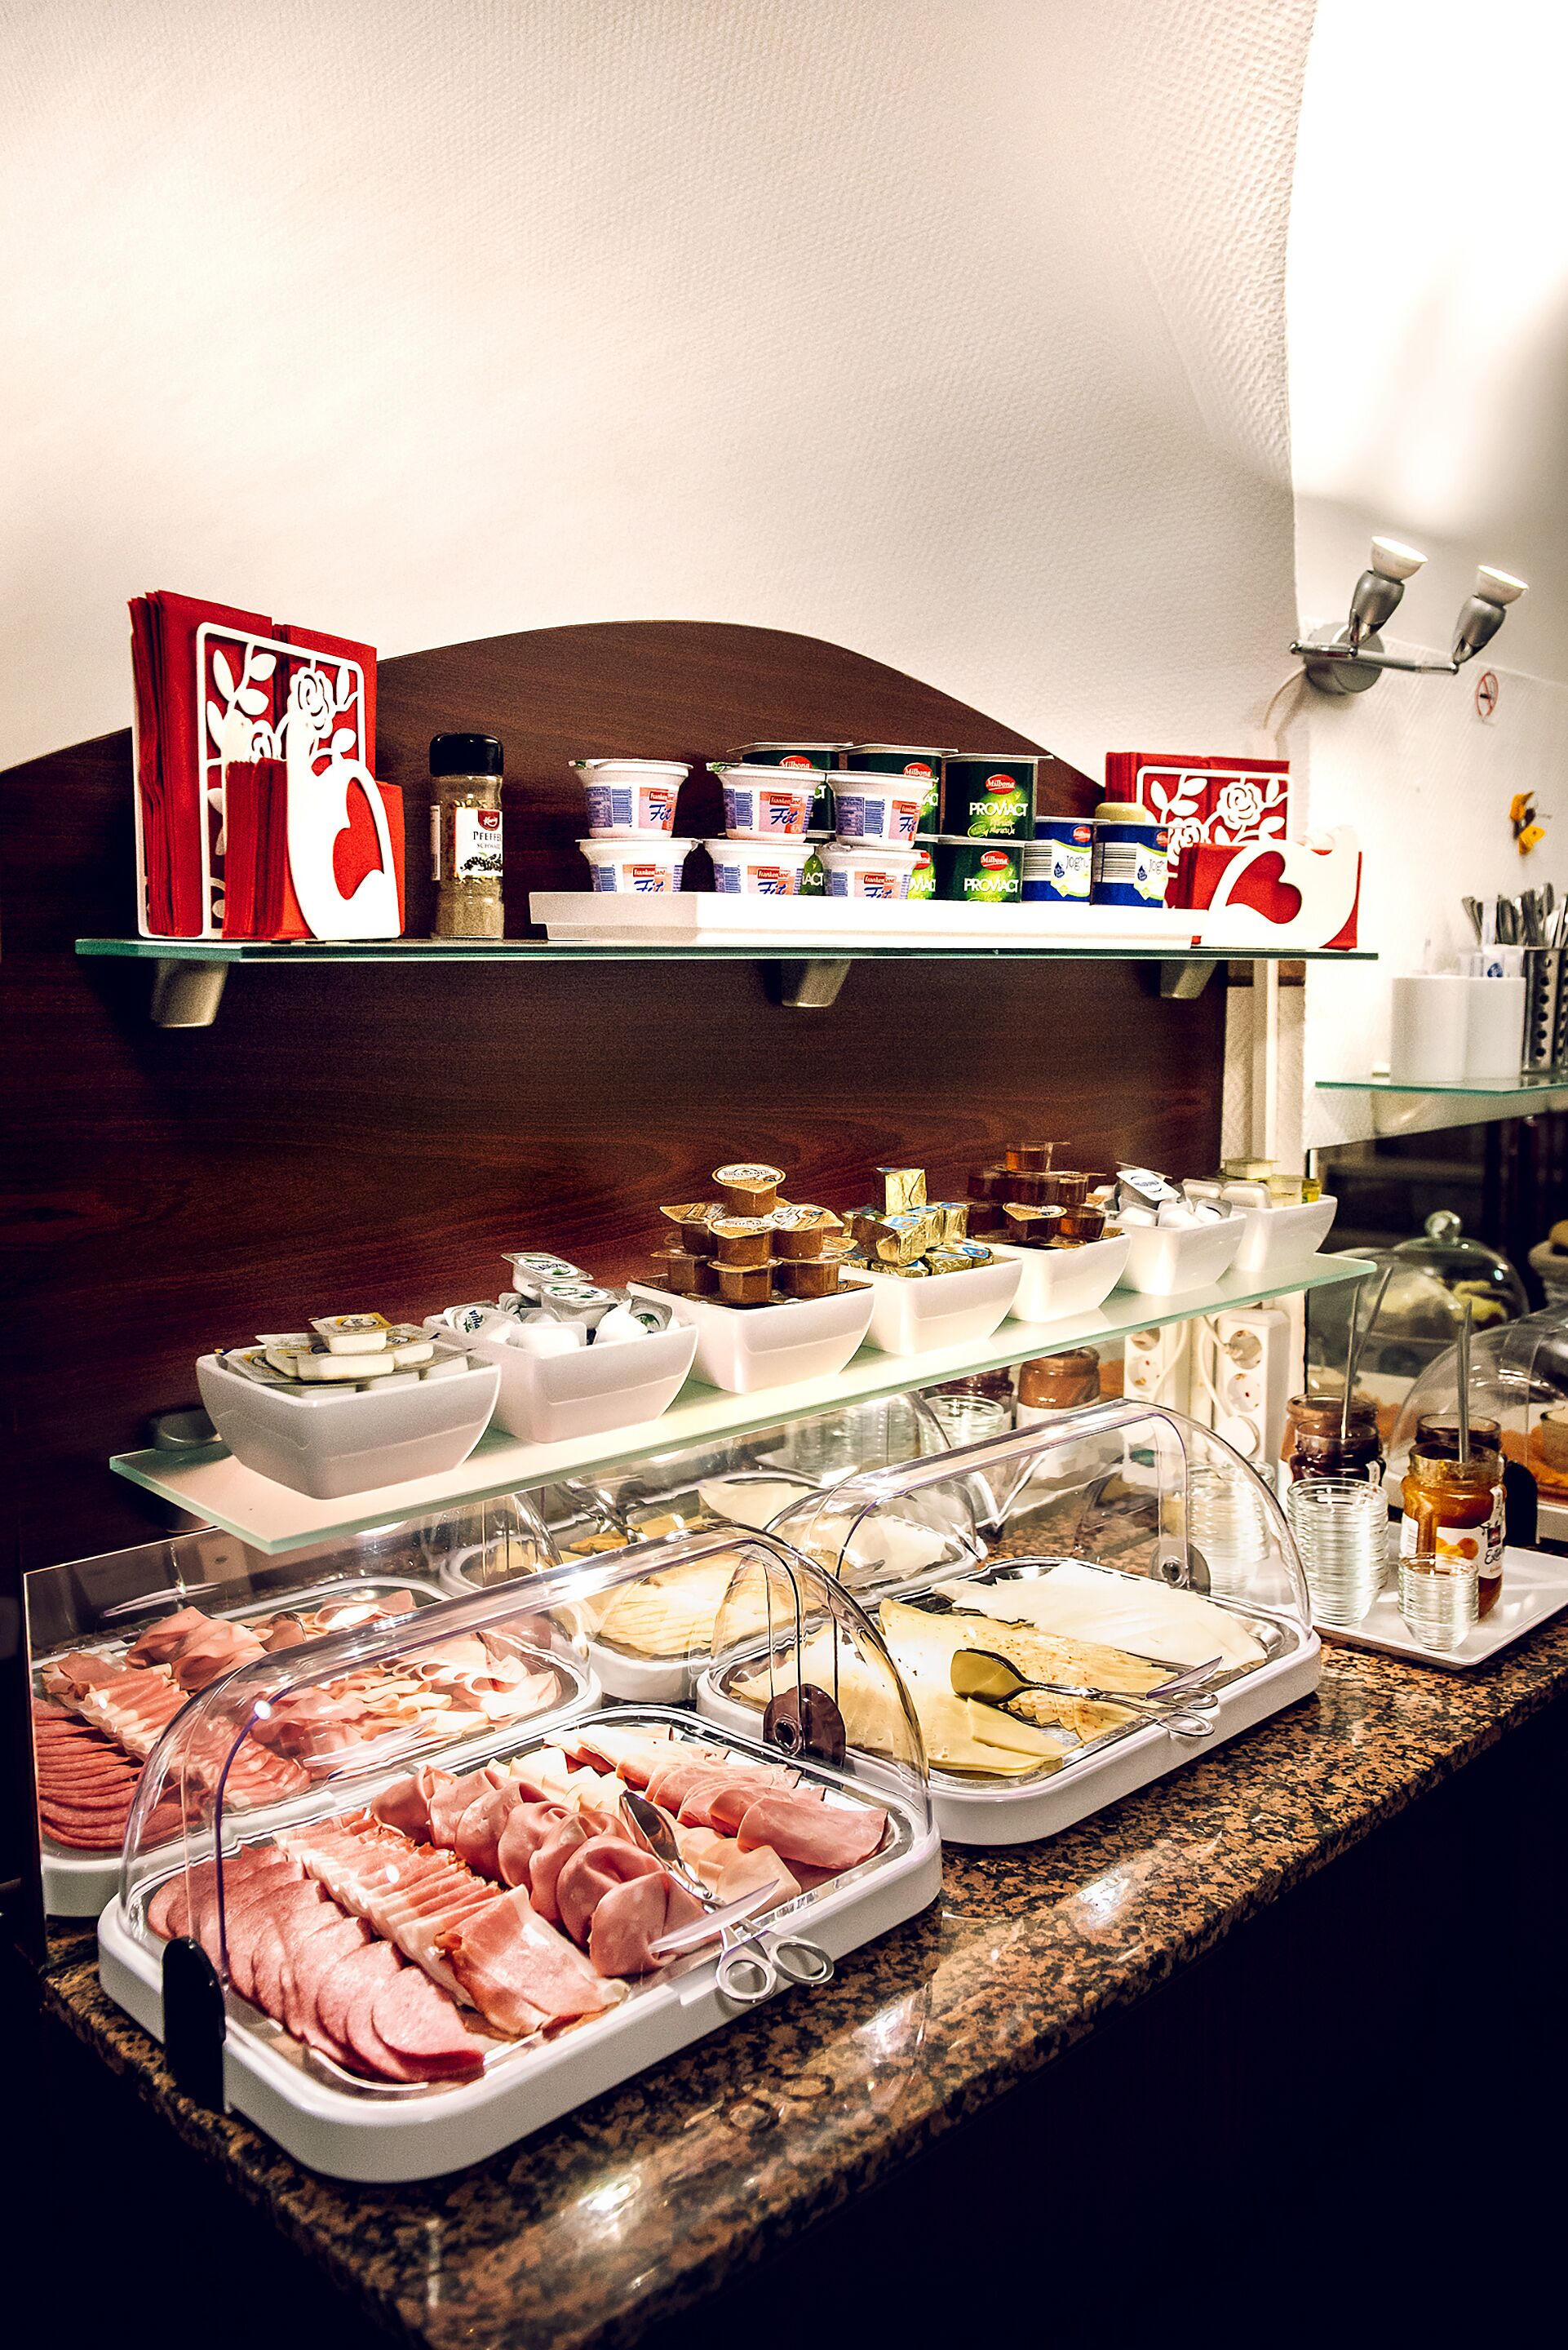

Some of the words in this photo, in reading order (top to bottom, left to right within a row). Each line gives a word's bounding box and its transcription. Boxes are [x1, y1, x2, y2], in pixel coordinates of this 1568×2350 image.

[986, 779, 1015, 788] Milbona
[649, 804, 672, 821] Fit
[769, 807, 799, 825] Fit
[981, 856, 1008, 864] Milbona
